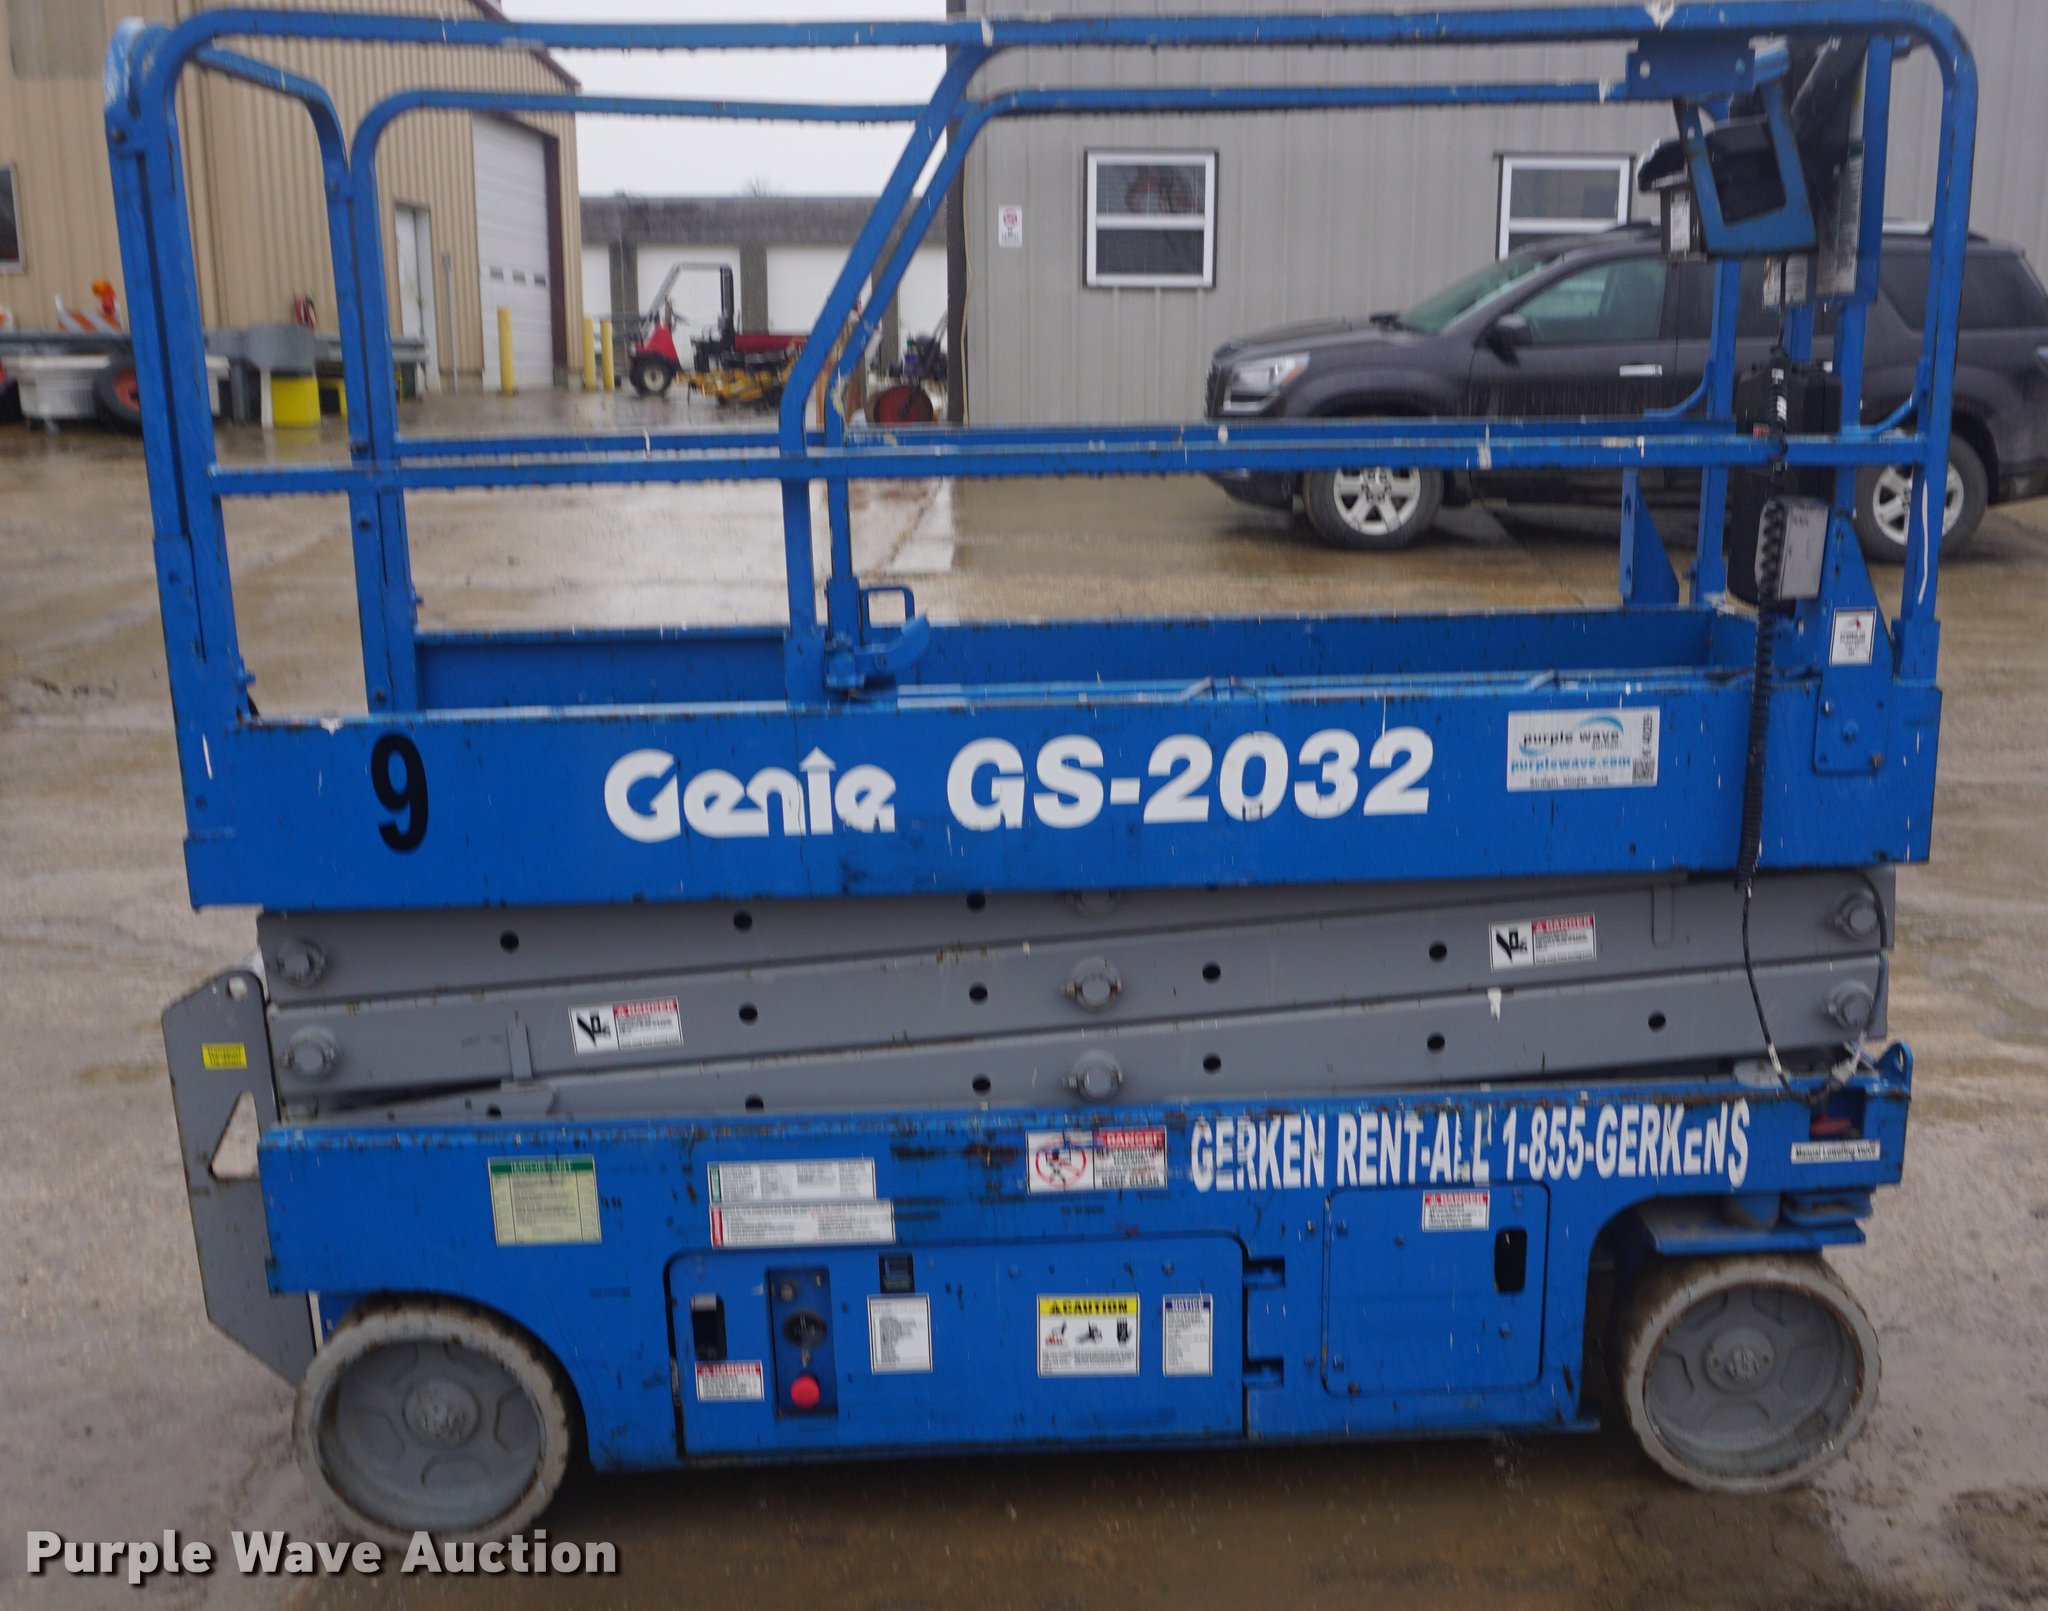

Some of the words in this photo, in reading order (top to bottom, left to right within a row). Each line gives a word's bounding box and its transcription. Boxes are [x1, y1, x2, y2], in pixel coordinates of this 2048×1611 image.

[1523, 731, 1573, 747] purple
[1580, 730, 1619, 743] wave
[1511, 756, 1631, 774] purplewave.com
[370, 731, 429, 854] 9
[604, 746, 896, 843] Genie
[946, 726, 1434, 832] GS-2032
[1545, 915, 1590, 932] DANGER
[1190, 1113, 1326, 1193] GERKEN
[1062, 1298, 1128, 1313] CAUTION
